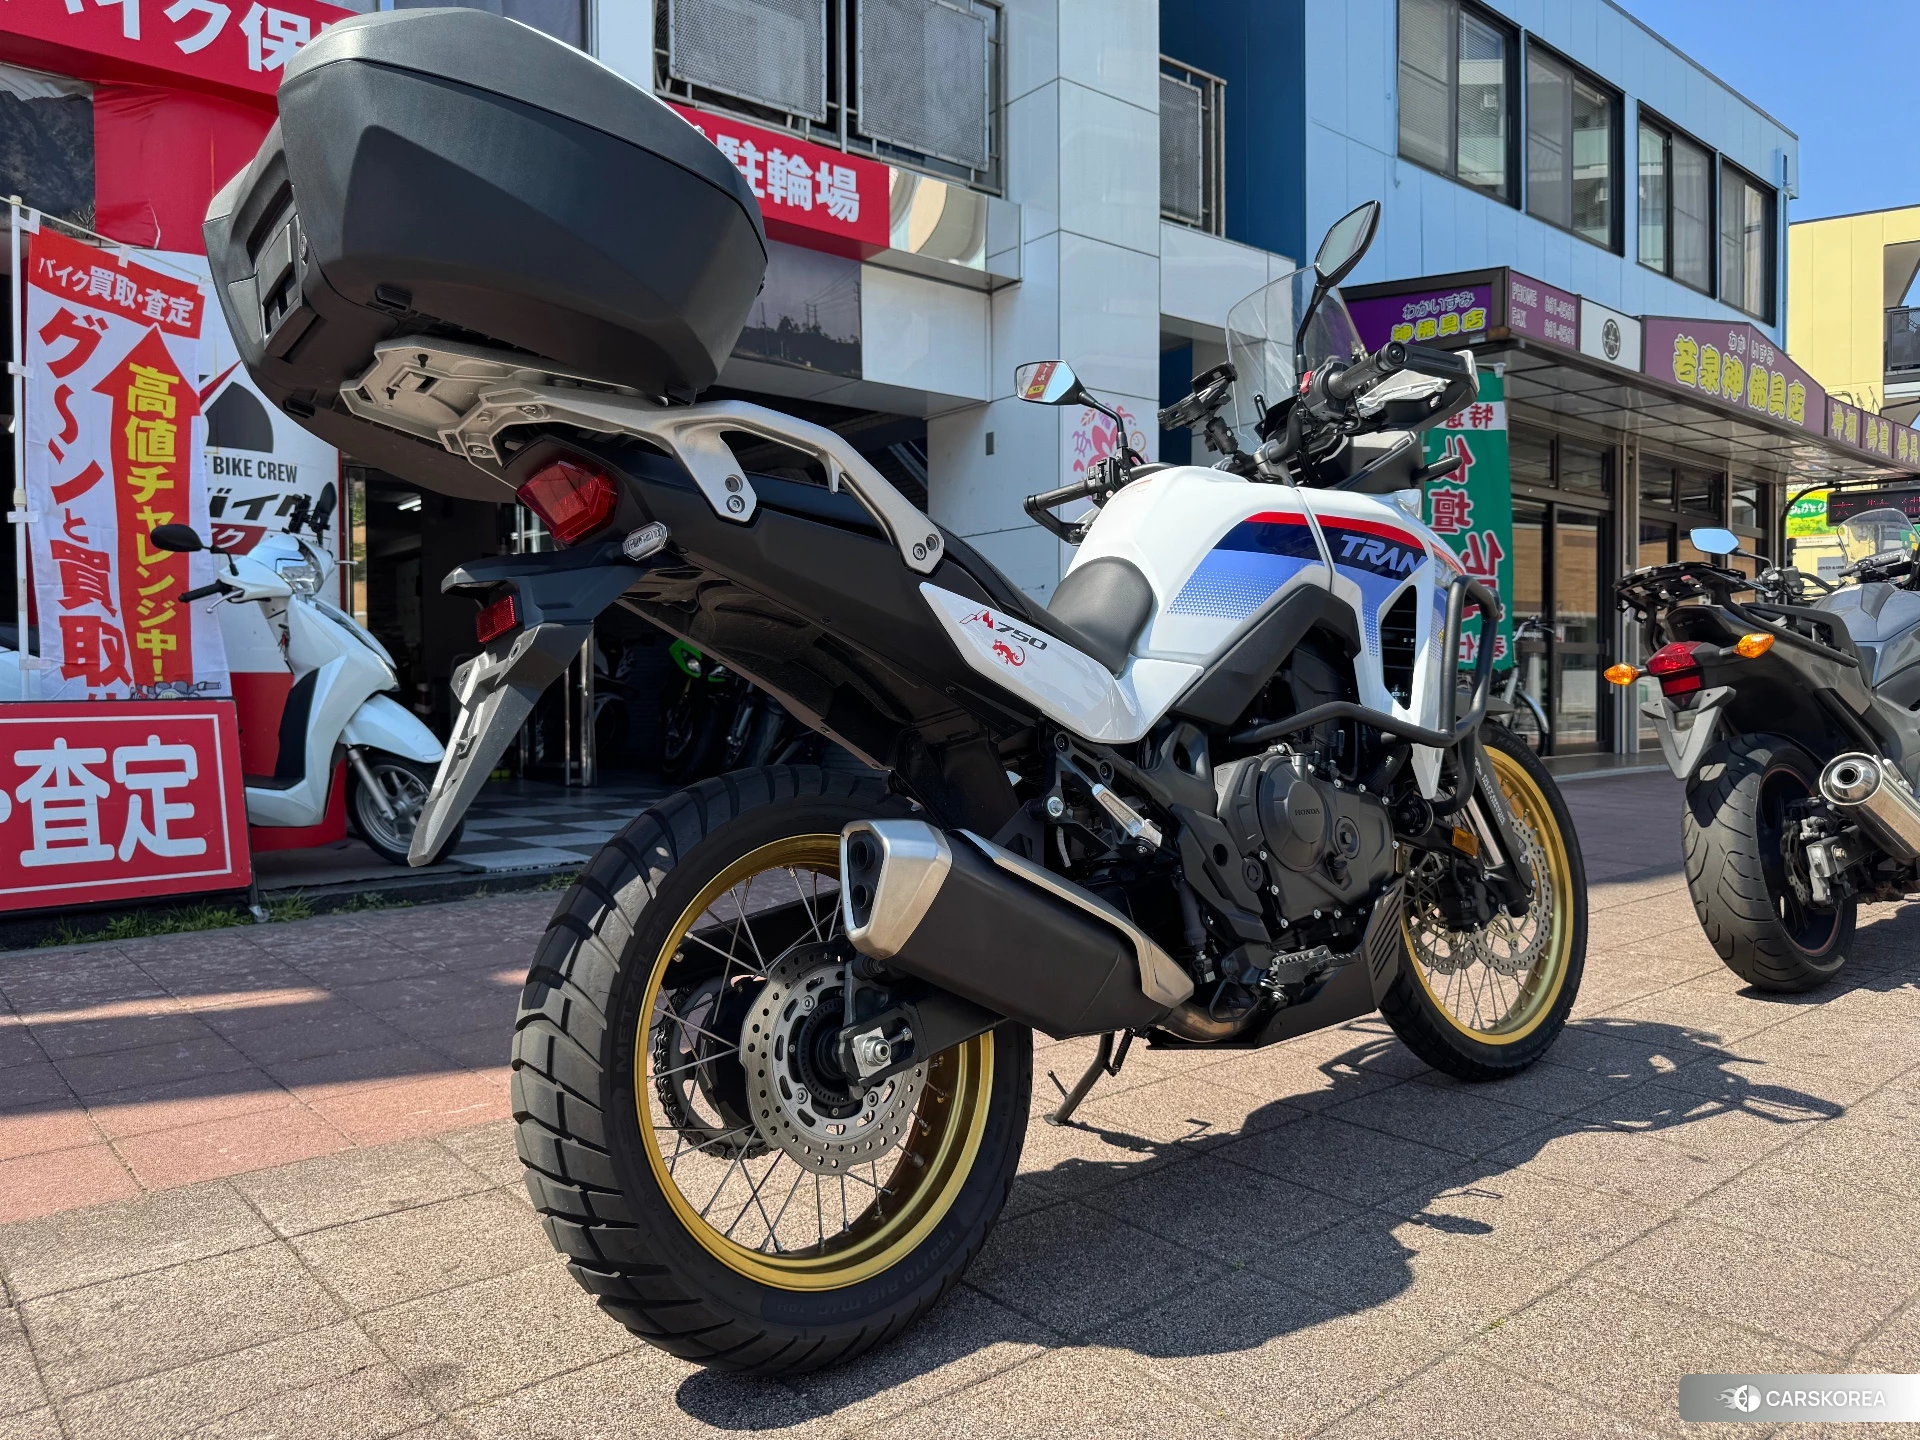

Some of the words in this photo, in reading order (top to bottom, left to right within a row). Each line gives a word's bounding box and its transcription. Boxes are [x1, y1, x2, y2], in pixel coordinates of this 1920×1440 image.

[2, 0, 335, 73] イク保
[694, 125, 860, 223] 駐輪場
[1402, 290, 1476, 320] わかいずみ
[1511, 282, 1538, 308] PHONE
[1511, 306, 1527, 329] FAX
[212, 455, 253, 478] BIKE
[257, 459, 298, 484] CREW
[995, 621, 1048, 651] 750
[1294, 807, 1321, 816] HONDA
